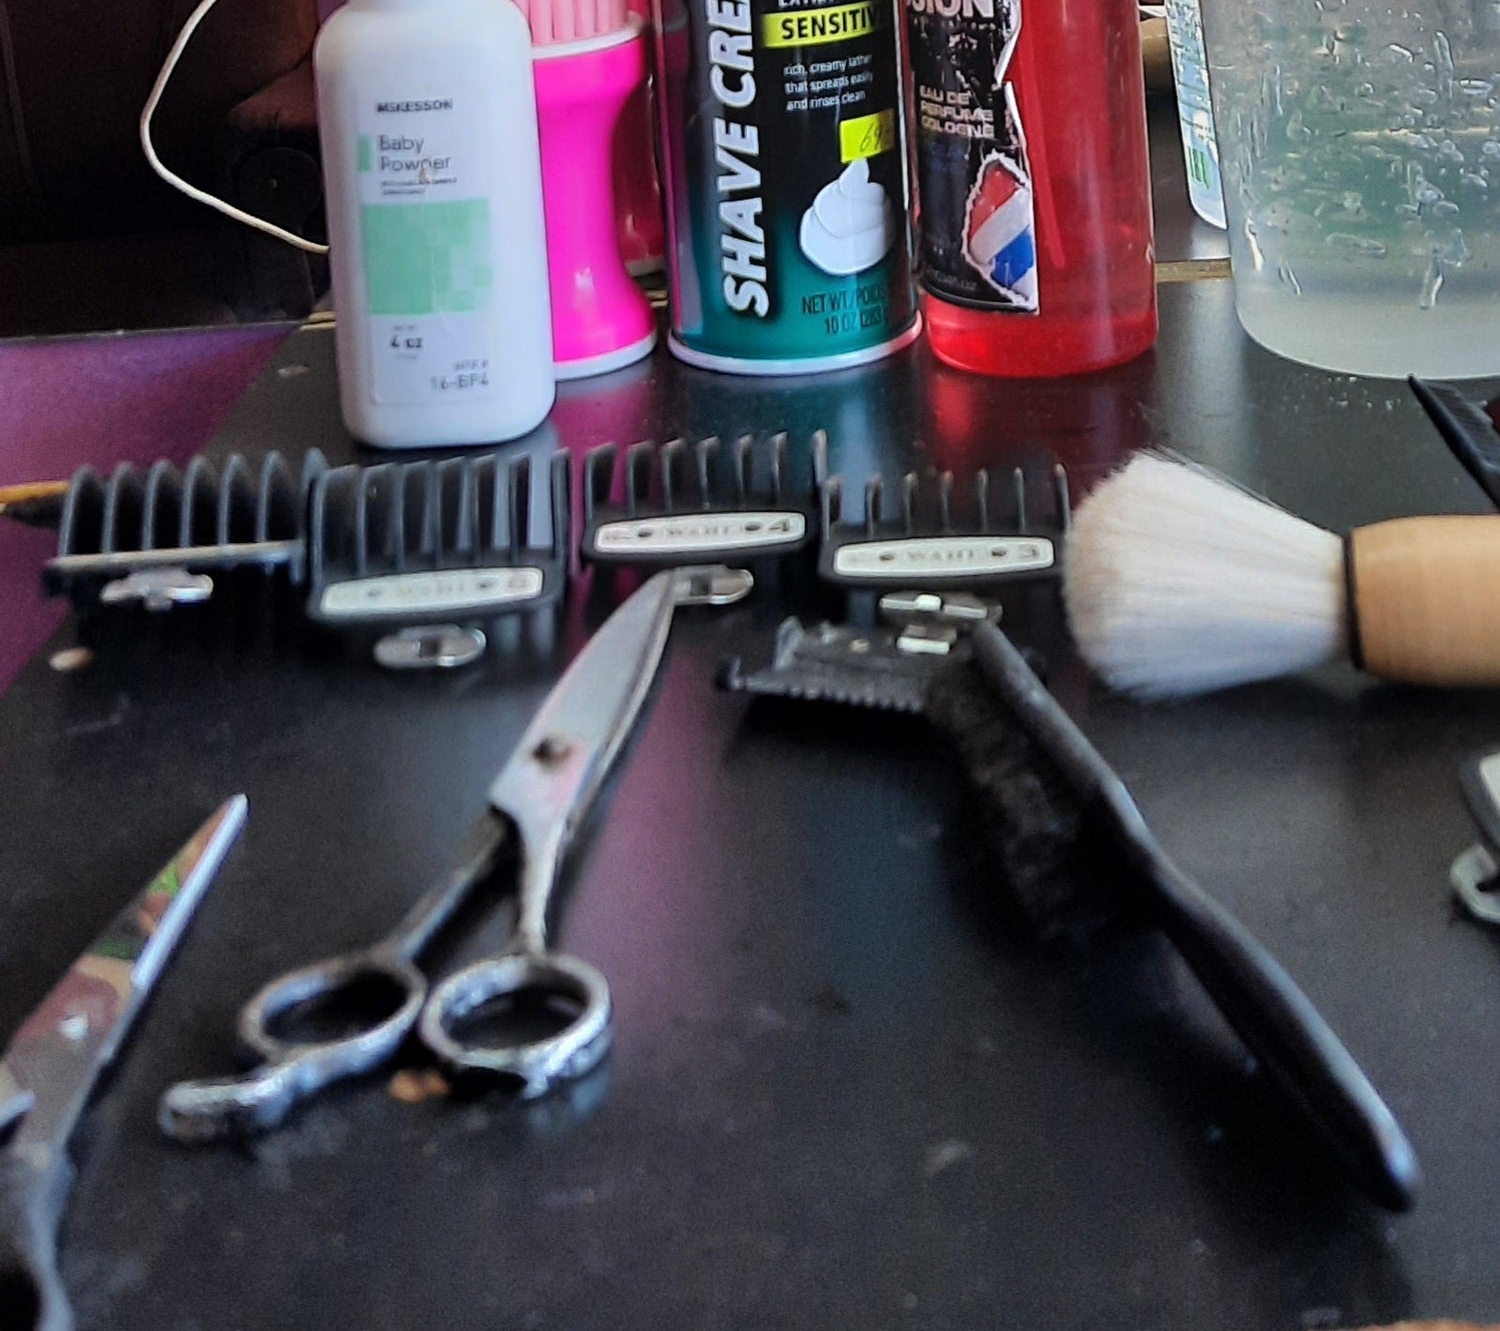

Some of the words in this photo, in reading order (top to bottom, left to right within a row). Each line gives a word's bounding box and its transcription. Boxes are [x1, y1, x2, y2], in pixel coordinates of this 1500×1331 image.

[809, 59, 847, 75] creamy
[785, 80, 808, 96] that
[809, 75, 849, 94] spreads
[786, 97, 808, 110] and
[809, 94, 840, 109] rinses
[841, 90, 866, 105] clean
[379, 134, 425, 155] Baby
[712, 117, 770, 318] SHAVE
[801, 293, 826, 314] NET
[825, 315, 839, 334] 10
